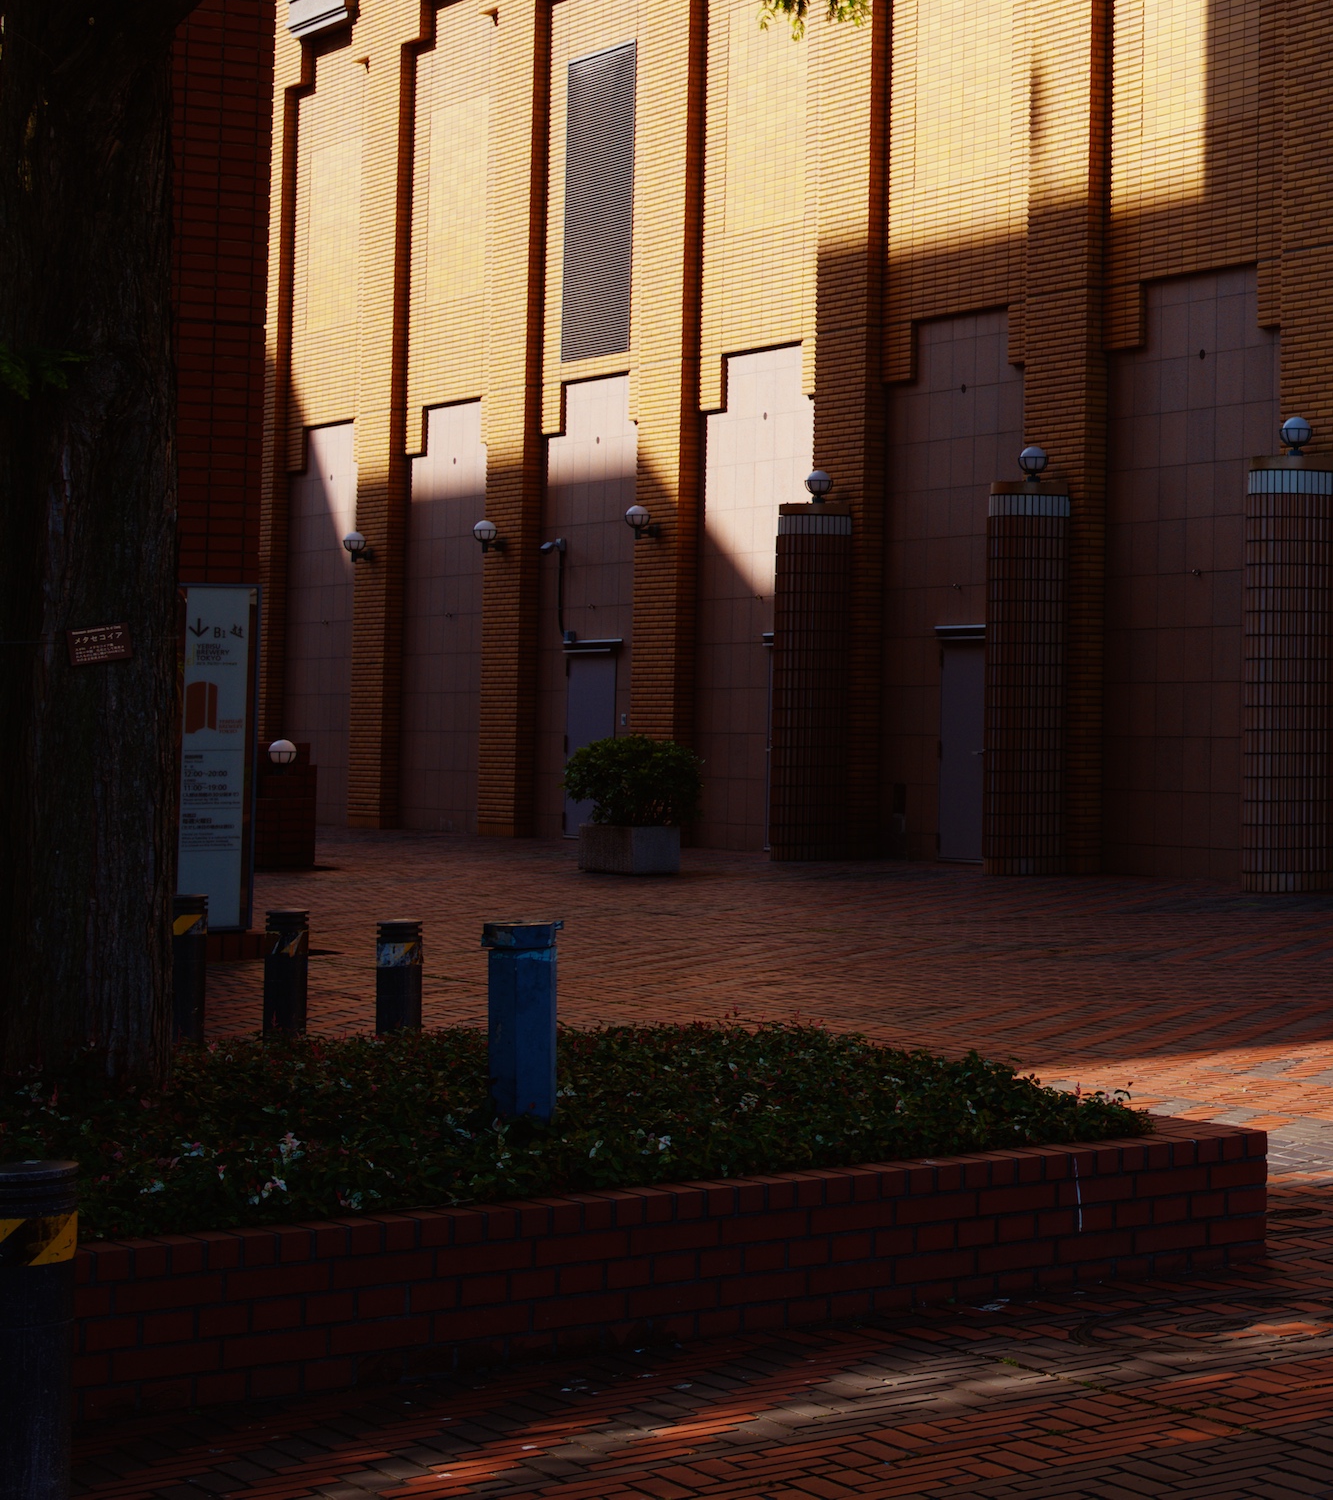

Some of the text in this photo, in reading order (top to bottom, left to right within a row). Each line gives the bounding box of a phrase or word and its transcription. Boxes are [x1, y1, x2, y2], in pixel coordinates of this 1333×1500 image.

[74, 631, 123, 645] メタセコイア
